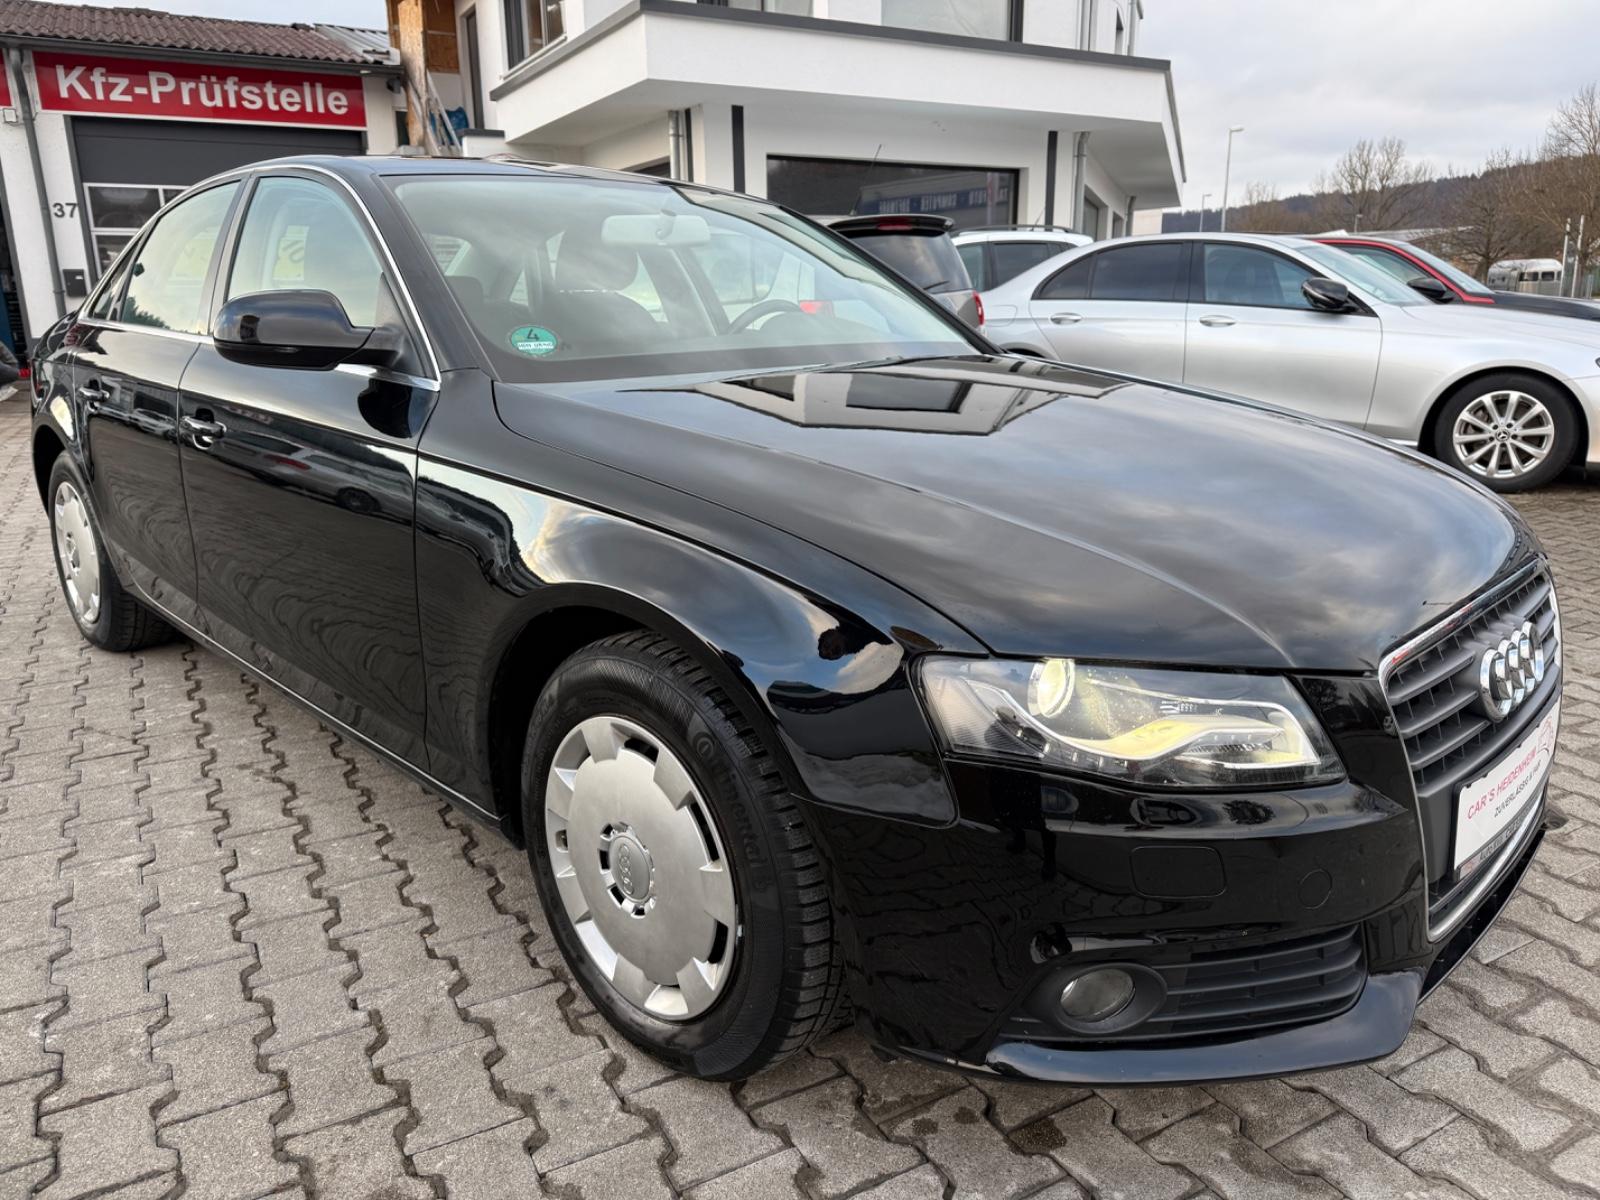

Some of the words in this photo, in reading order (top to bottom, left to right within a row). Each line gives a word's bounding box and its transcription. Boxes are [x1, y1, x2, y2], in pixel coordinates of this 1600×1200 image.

[55, 65, 349, 115] Kfz-Prüfstelle
[52, 202, 79, 218] 37
[526, 328, 540, 341] 4
[1466, 787, 1495, 819] CAR'S
